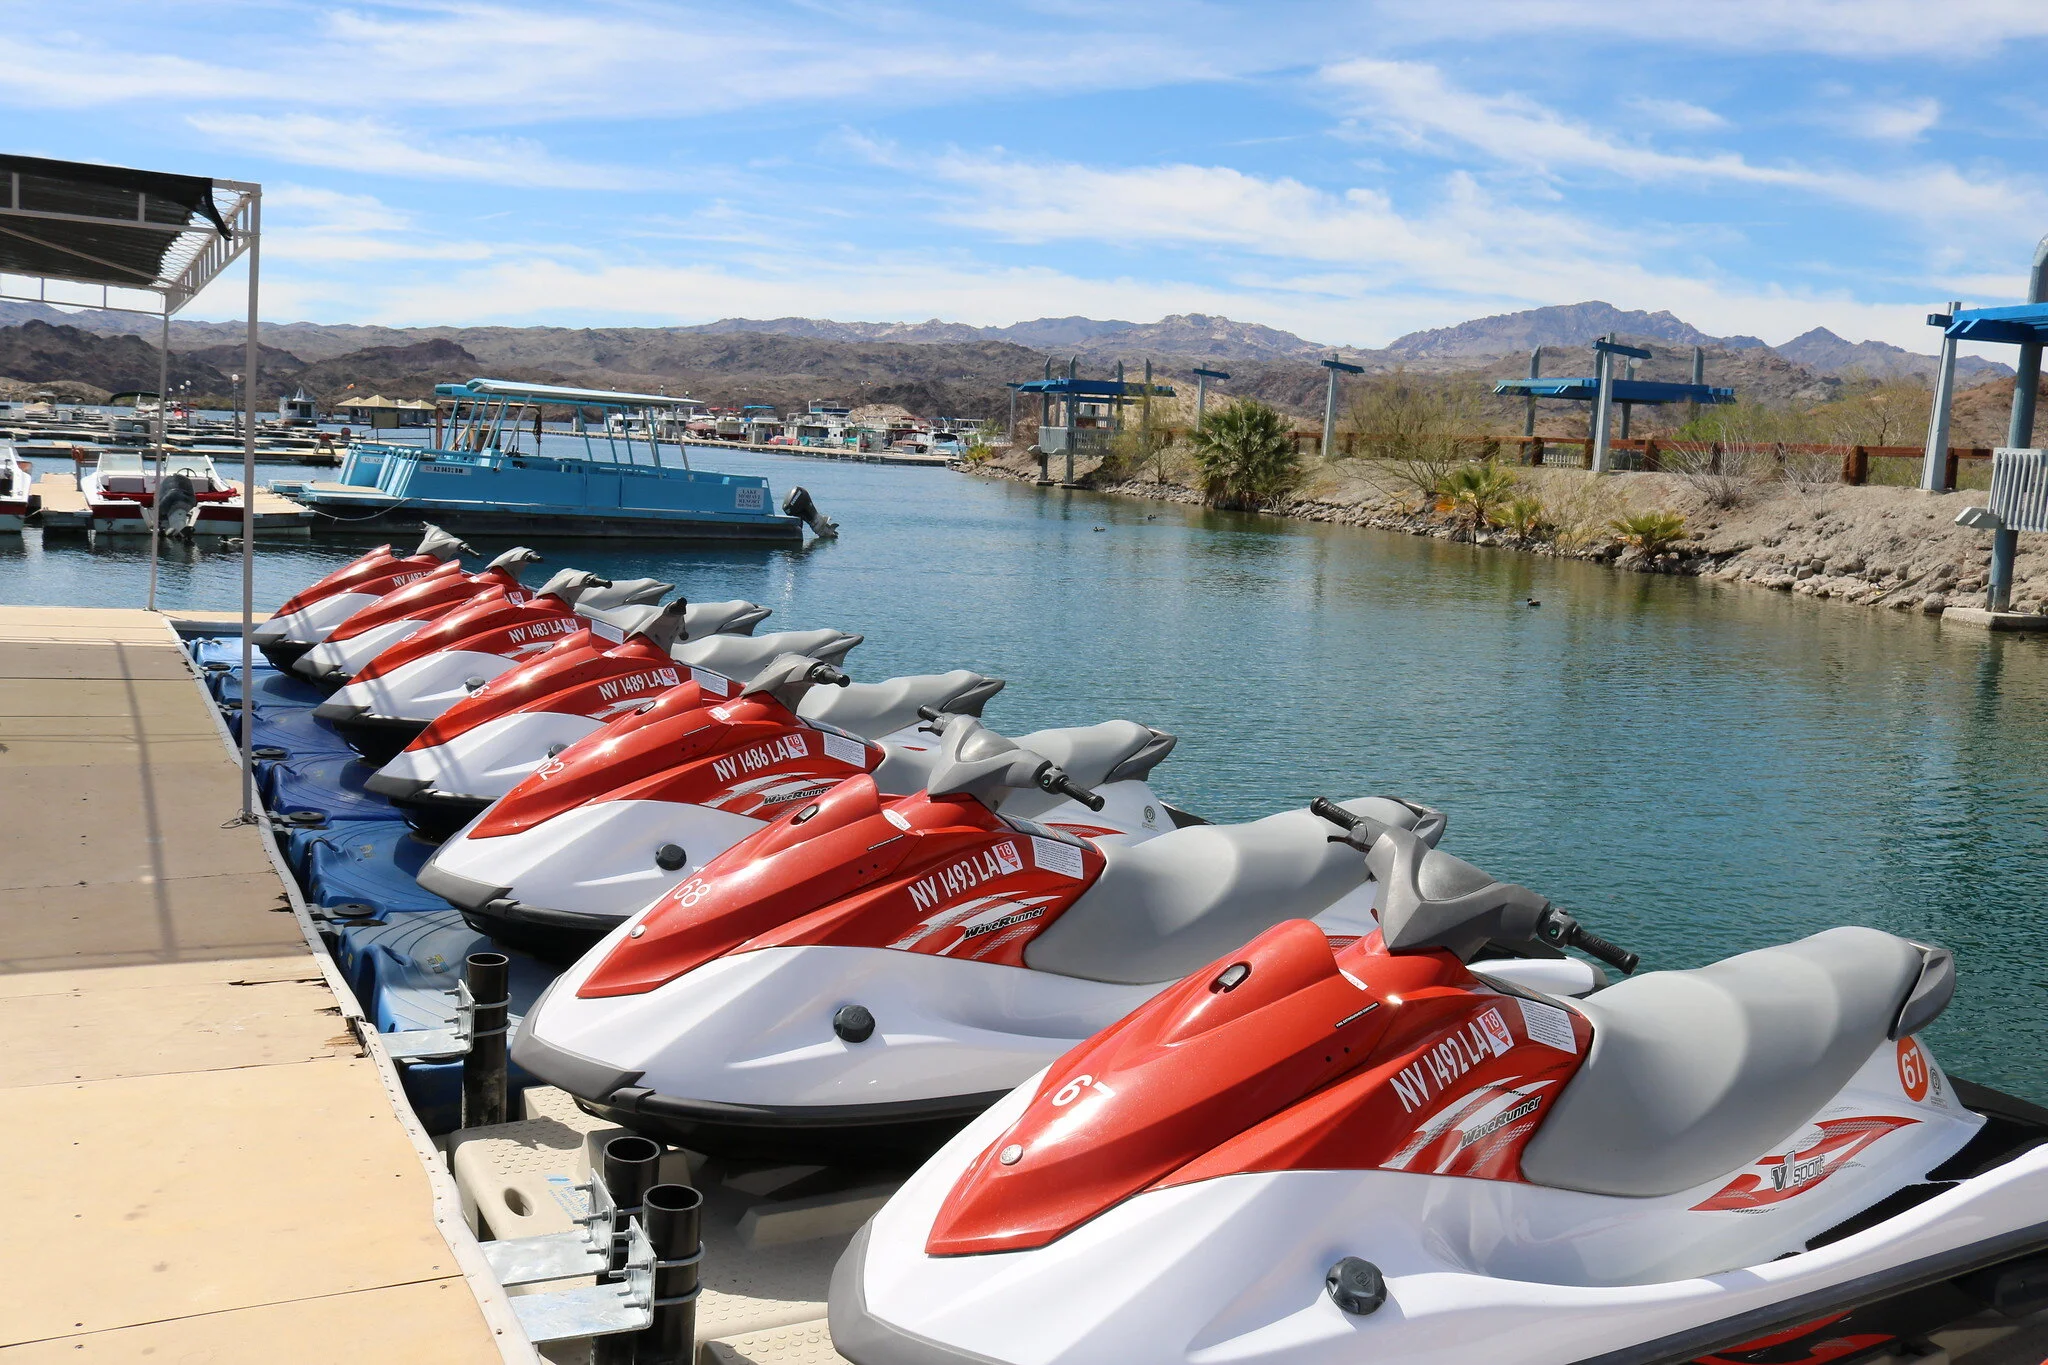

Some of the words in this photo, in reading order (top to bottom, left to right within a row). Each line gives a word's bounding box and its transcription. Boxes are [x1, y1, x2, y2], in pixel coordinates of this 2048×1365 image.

[107, 521, 113, 530] 2
[392, 575, 405, 587] NV
[508, 627, 525, 643] NV
[527, 623, 549, 639] 1483
[548, 620, 564, 633] LA
[598, 681, 619, 700] NV
[620, 674, 645, 695] 1489
[644, 670, 664, 688] LA
[789, 735, 800, 746] 18
[712, 756, 738, 782] NV
[738, 746, 769, 773] 1486
[767, 740, 790, 764] LA
[999, 844, 1012, 857] 18
[674, 878, 711, 908] 68
[907, 876, 939, 912] NV
[938, 860, 977, 898] 1493
[972, 850, 1001, 882] LA
[963, 906, 1047, 940] WaveRunner
[1484, 1011, 1500, 1032] 18
[1389, 1061, 1430, 1114] NV
[1423, 1037, 1470, 1091] 1492
[1457, 1022, 1492, 1066] LA
[1901, 1046, 1923, 1090] 67
[1460, 1095, 1542, 1149] WaveRunner
